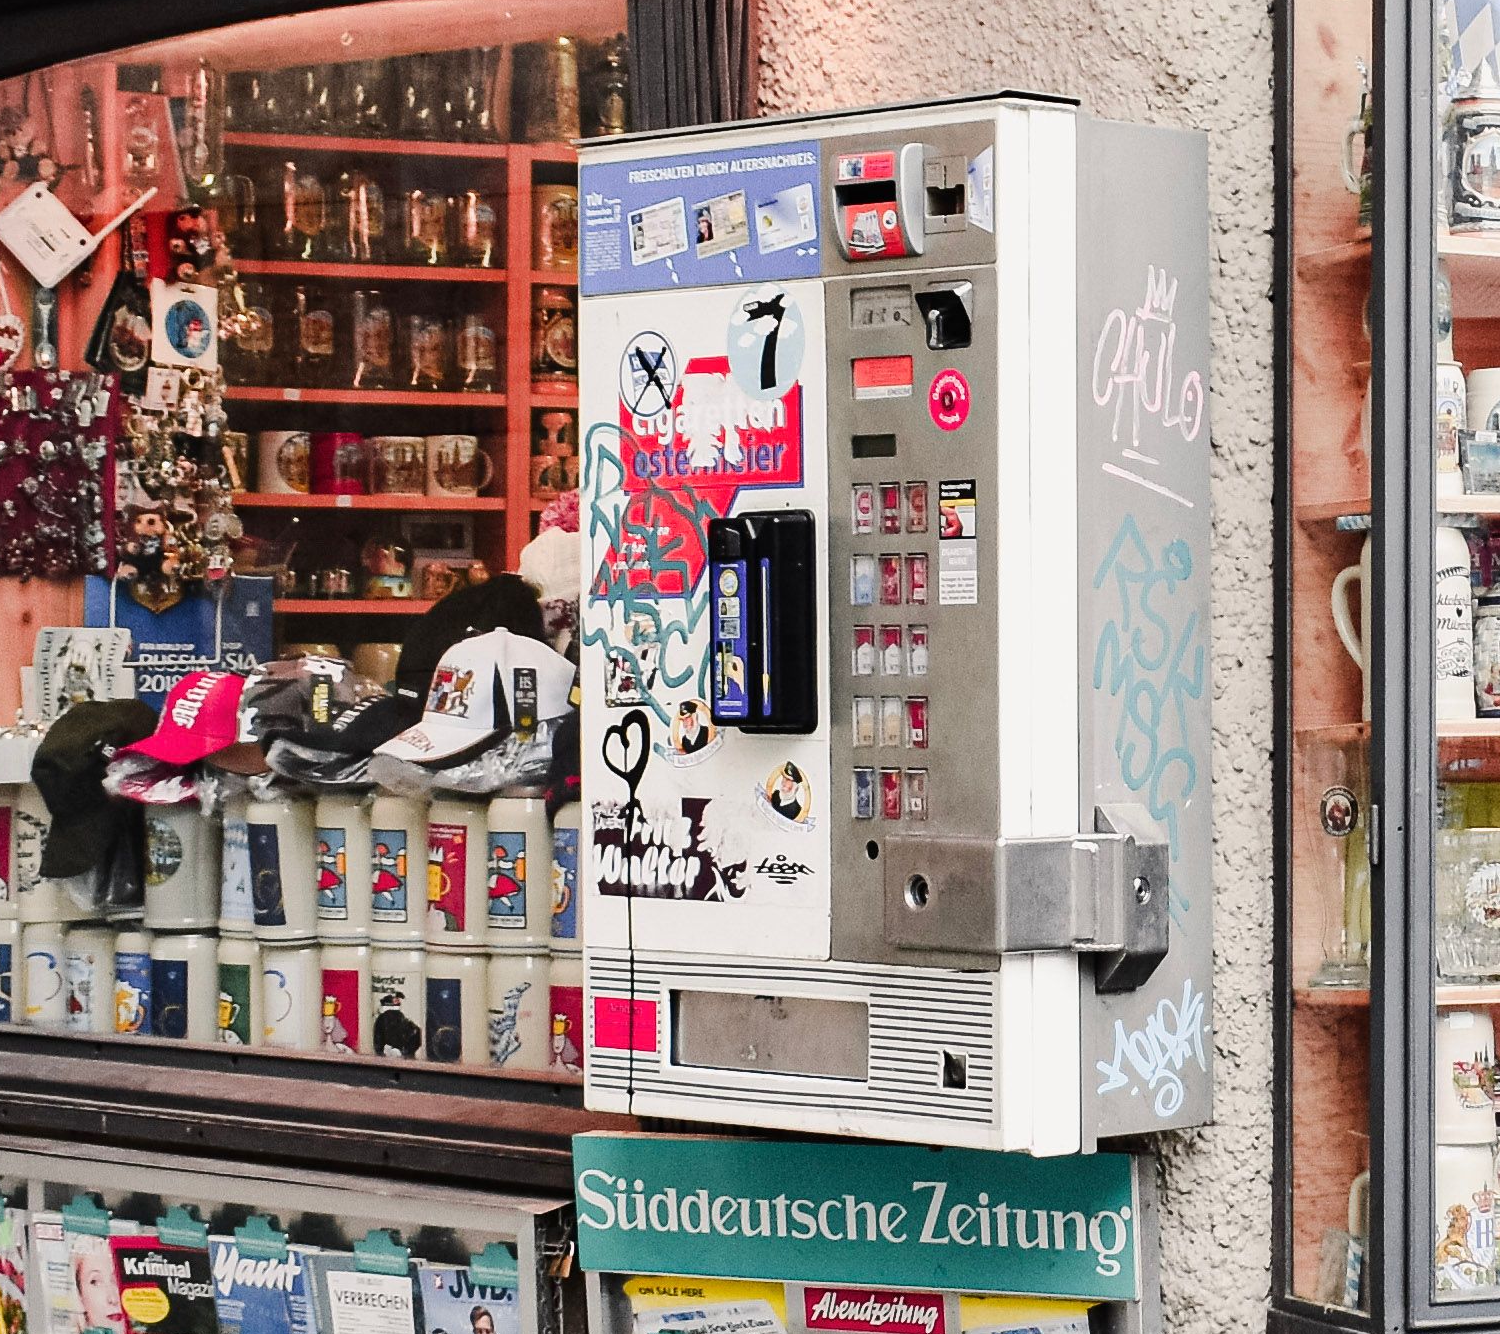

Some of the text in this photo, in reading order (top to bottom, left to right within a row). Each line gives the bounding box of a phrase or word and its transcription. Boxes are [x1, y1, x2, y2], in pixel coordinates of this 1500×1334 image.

[577, 1169, 1131, 1276] Süddeutsche Zeitung
[123, 1257, 190, 1278] Kriminal
[333, 1288, 410, 1311] VERBRECHEN
[656, 1287, 678, 1297] SALE
[812, 1291, 938, 1334] Abendzeitung
